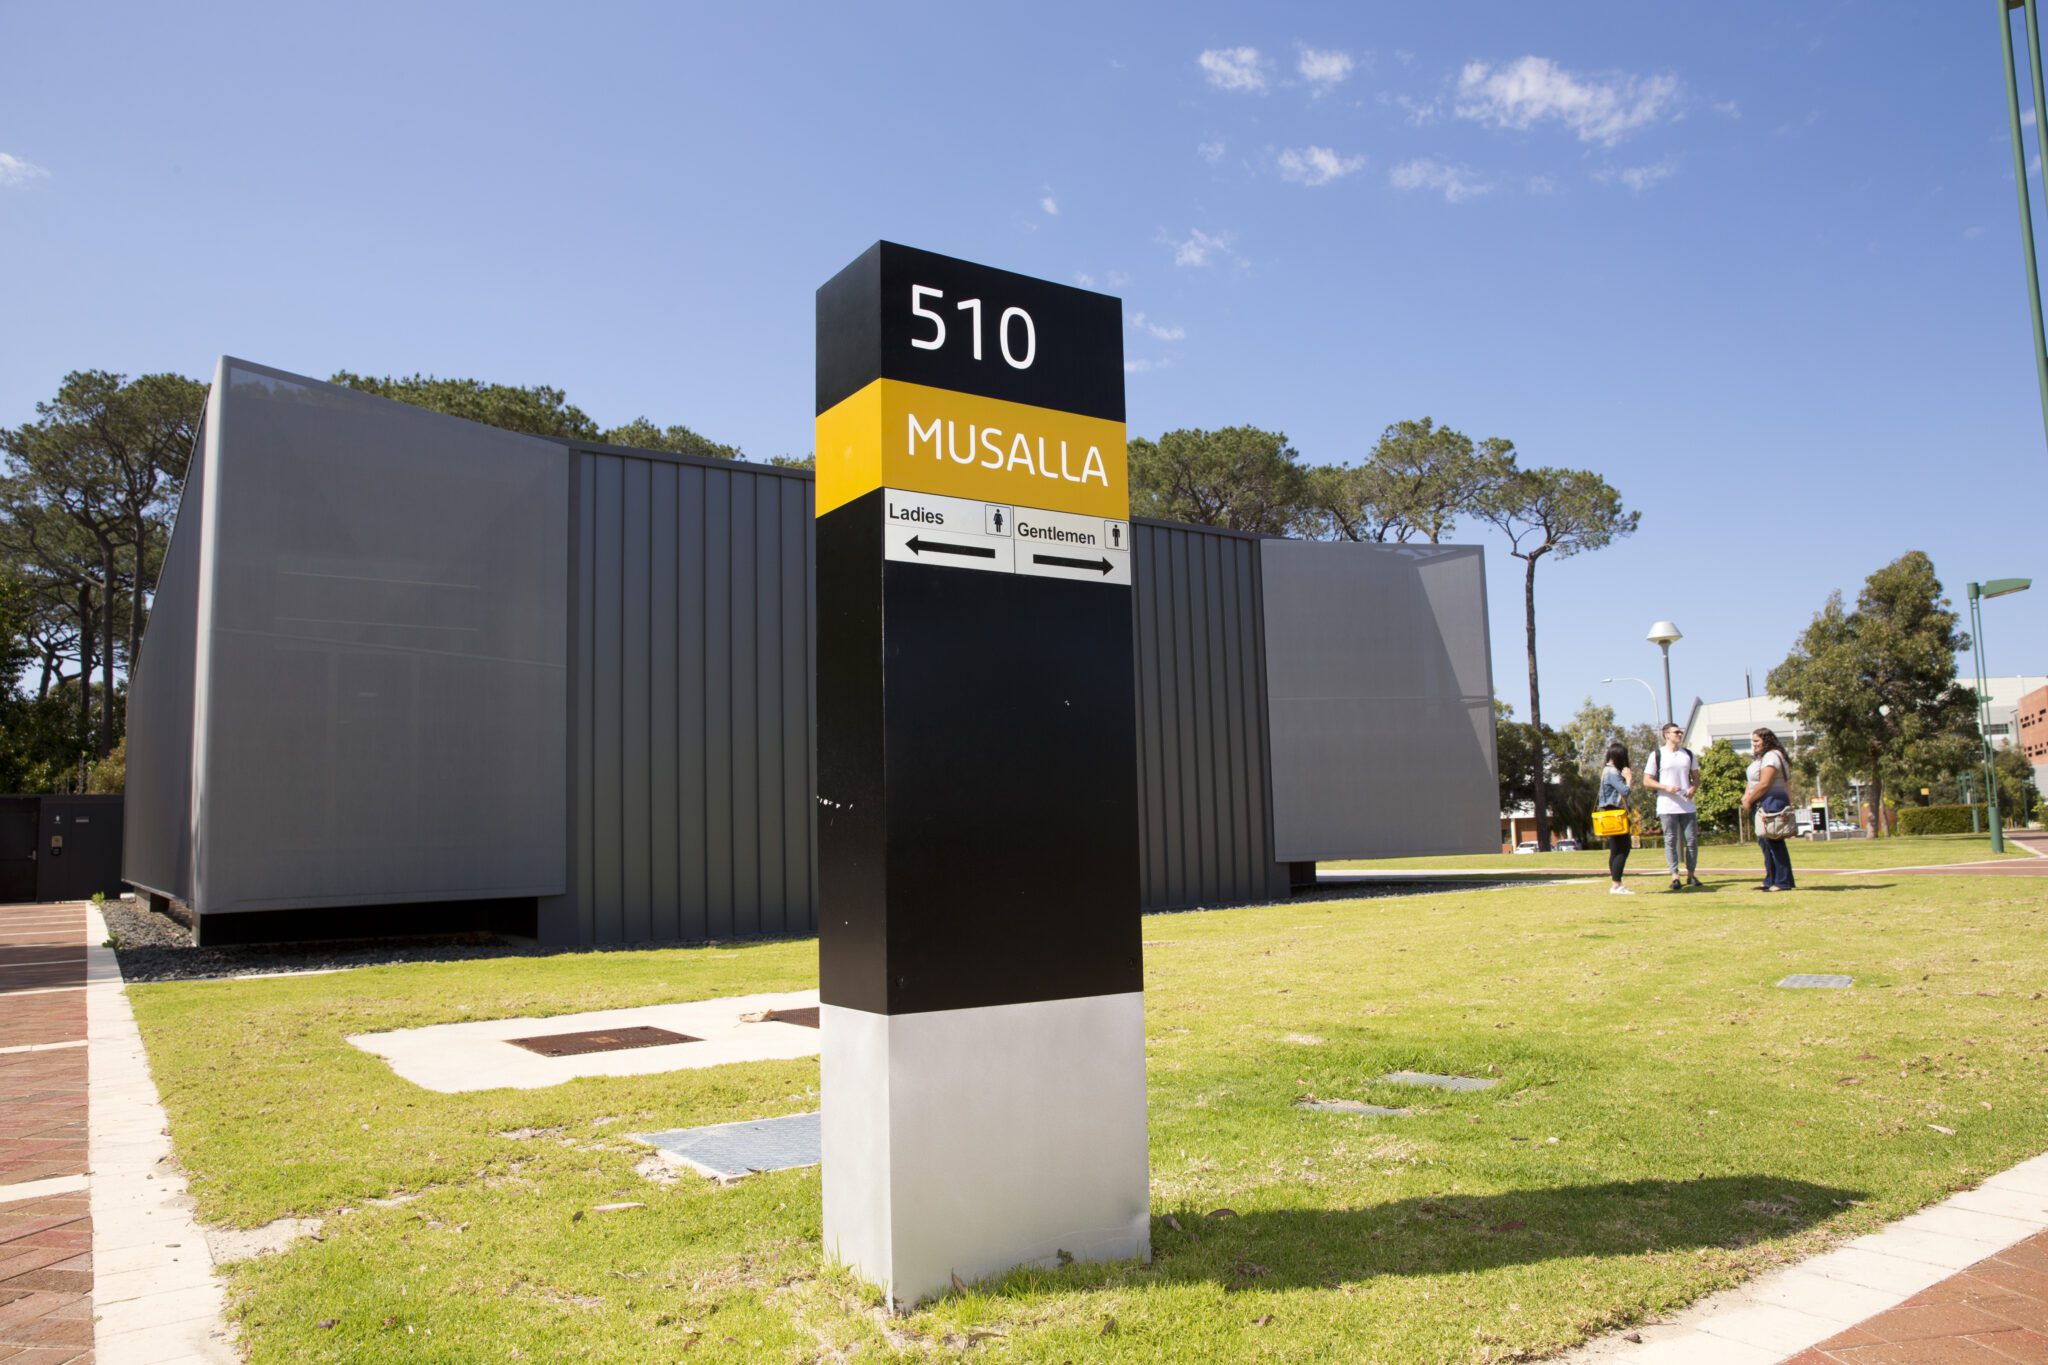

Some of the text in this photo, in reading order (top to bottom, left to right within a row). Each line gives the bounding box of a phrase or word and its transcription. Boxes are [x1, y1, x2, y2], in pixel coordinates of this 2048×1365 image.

[911, 284, 1036, 370] 510
[908, 413, 1109, 487] MUSALLA
[889, 503, 944, 525] Ladies
[1017, 522, 1096, 545] Gentlemen
